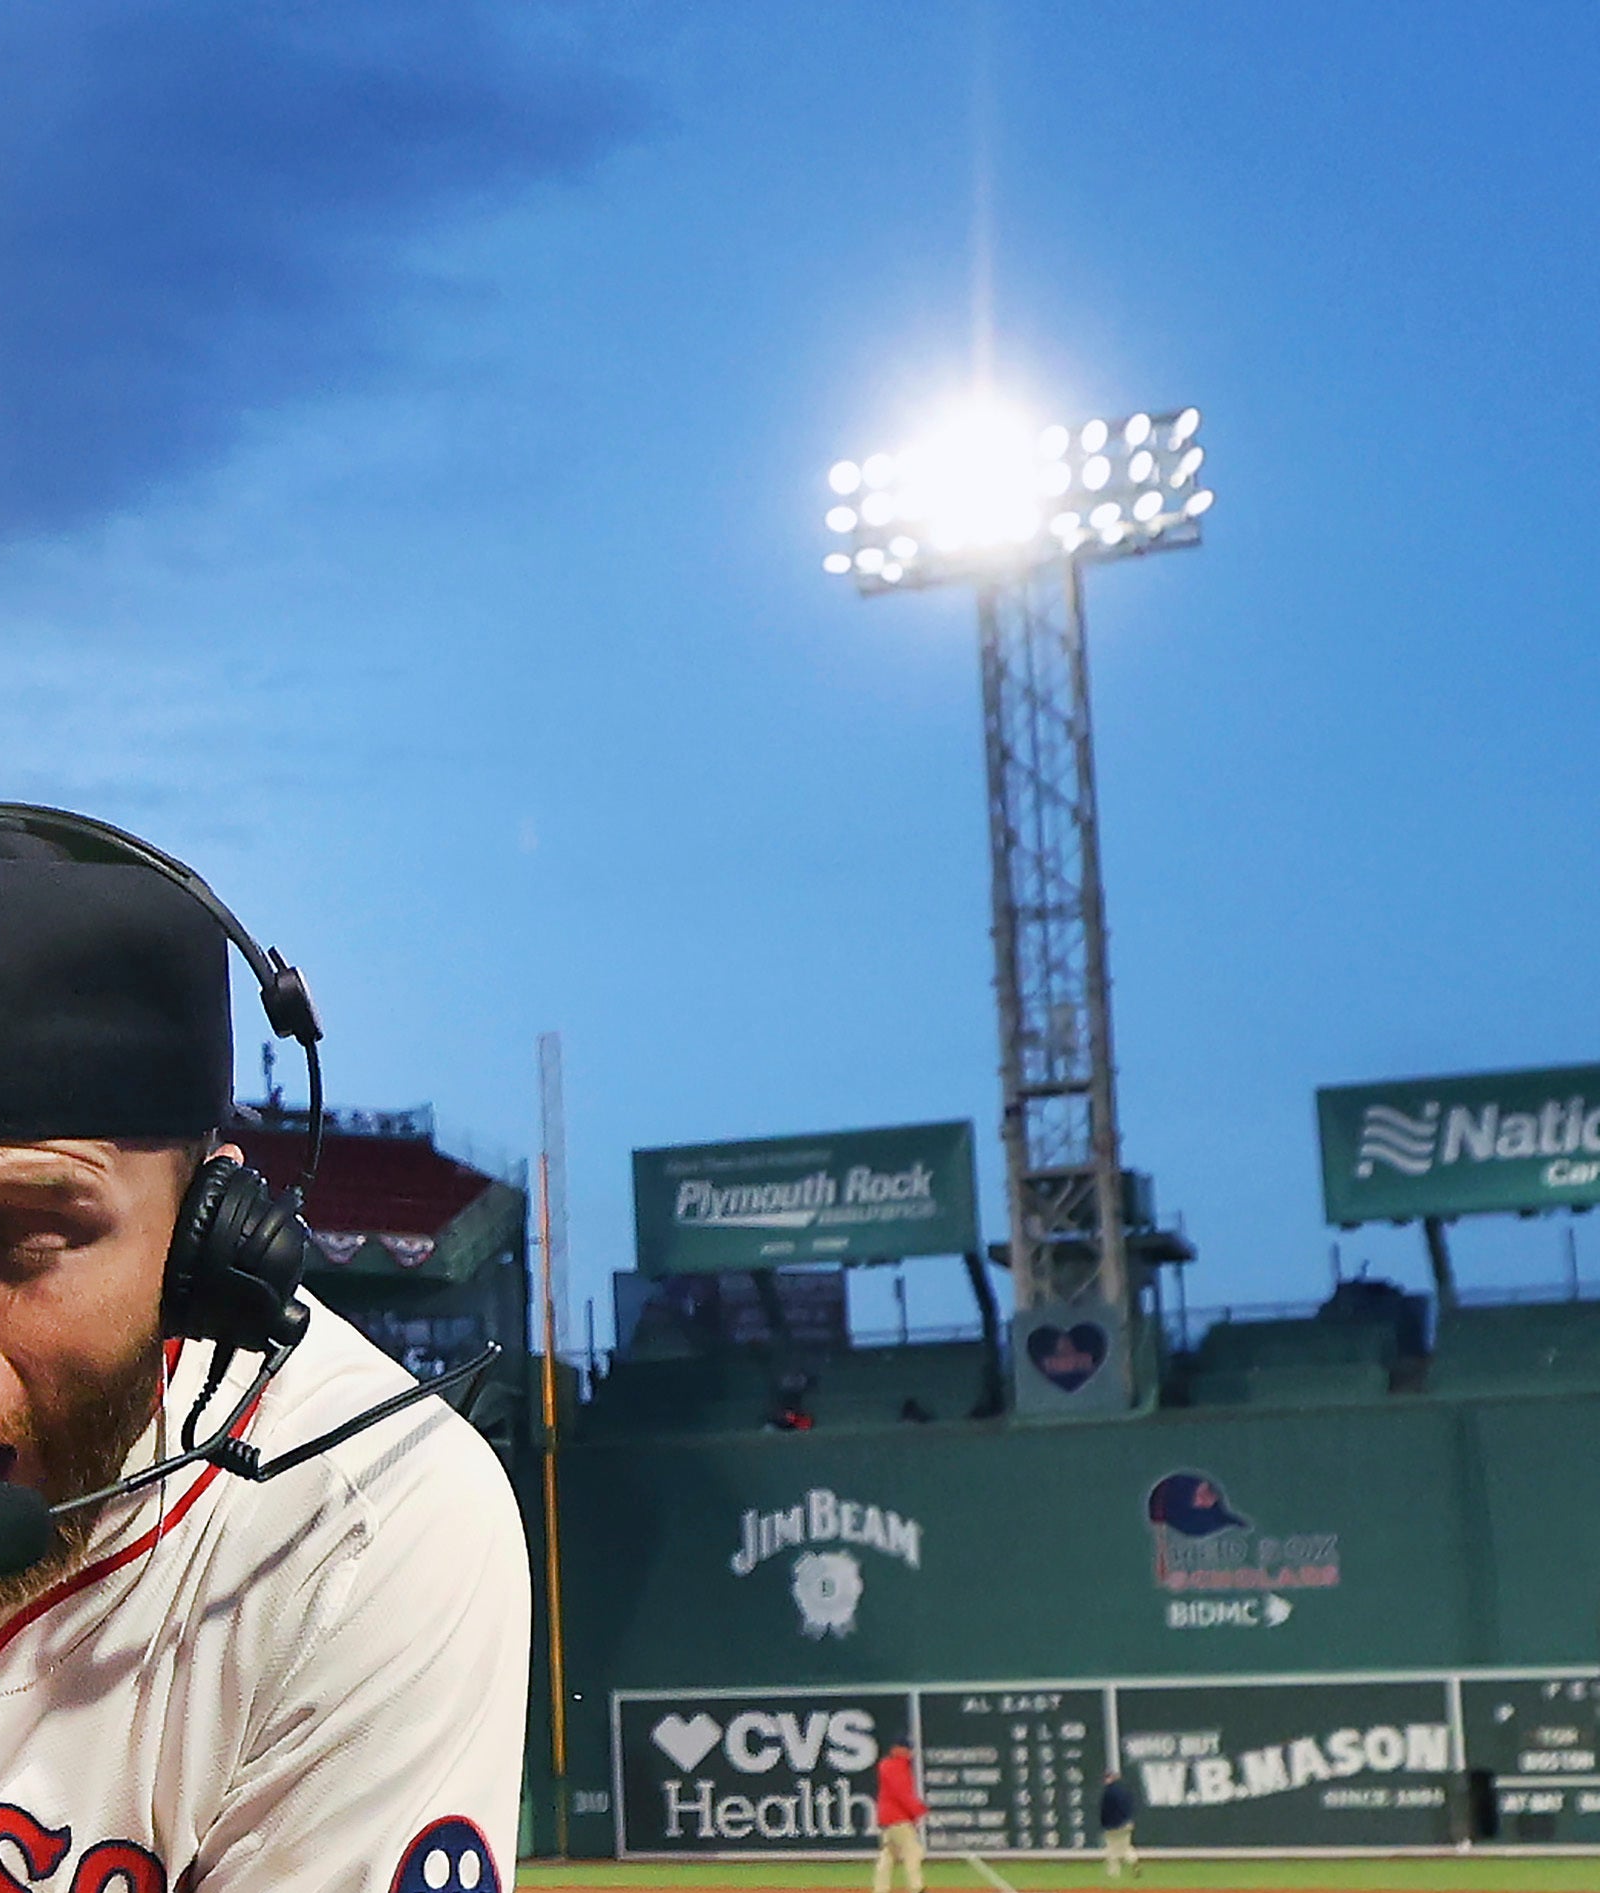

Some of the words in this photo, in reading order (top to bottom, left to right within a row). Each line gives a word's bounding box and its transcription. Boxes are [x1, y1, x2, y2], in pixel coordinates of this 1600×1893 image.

[674, 1170, 837, 1221] Plymouth
[846, 1161, 934, 1204] Rock
[730, 1507, 805, 1577] JIM
[807, 1487, 923, 1570] BEAM
[1166, 1599, 1258, 1628] BIDMC
[725, 1708, 879, 1774] CVS
[661, 1776, 881, 1839] Health
